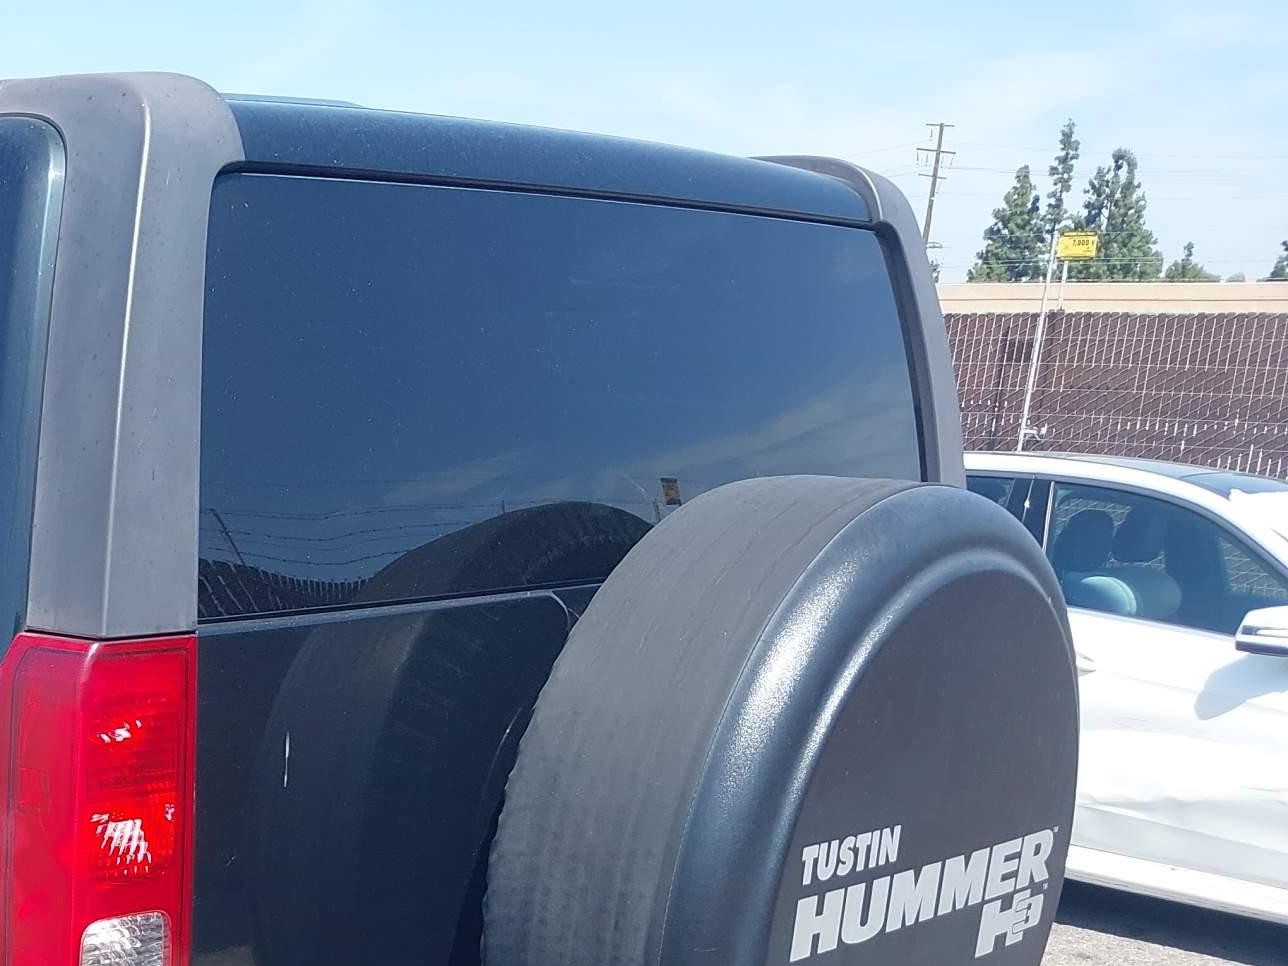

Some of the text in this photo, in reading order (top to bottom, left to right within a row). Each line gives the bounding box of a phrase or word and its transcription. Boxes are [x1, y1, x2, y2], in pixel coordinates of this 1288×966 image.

[802, 825, 902, 886] TUSTIN
[790, 828, 1054, 963] HUMMER
[974, 889, 1044, 958] H3
